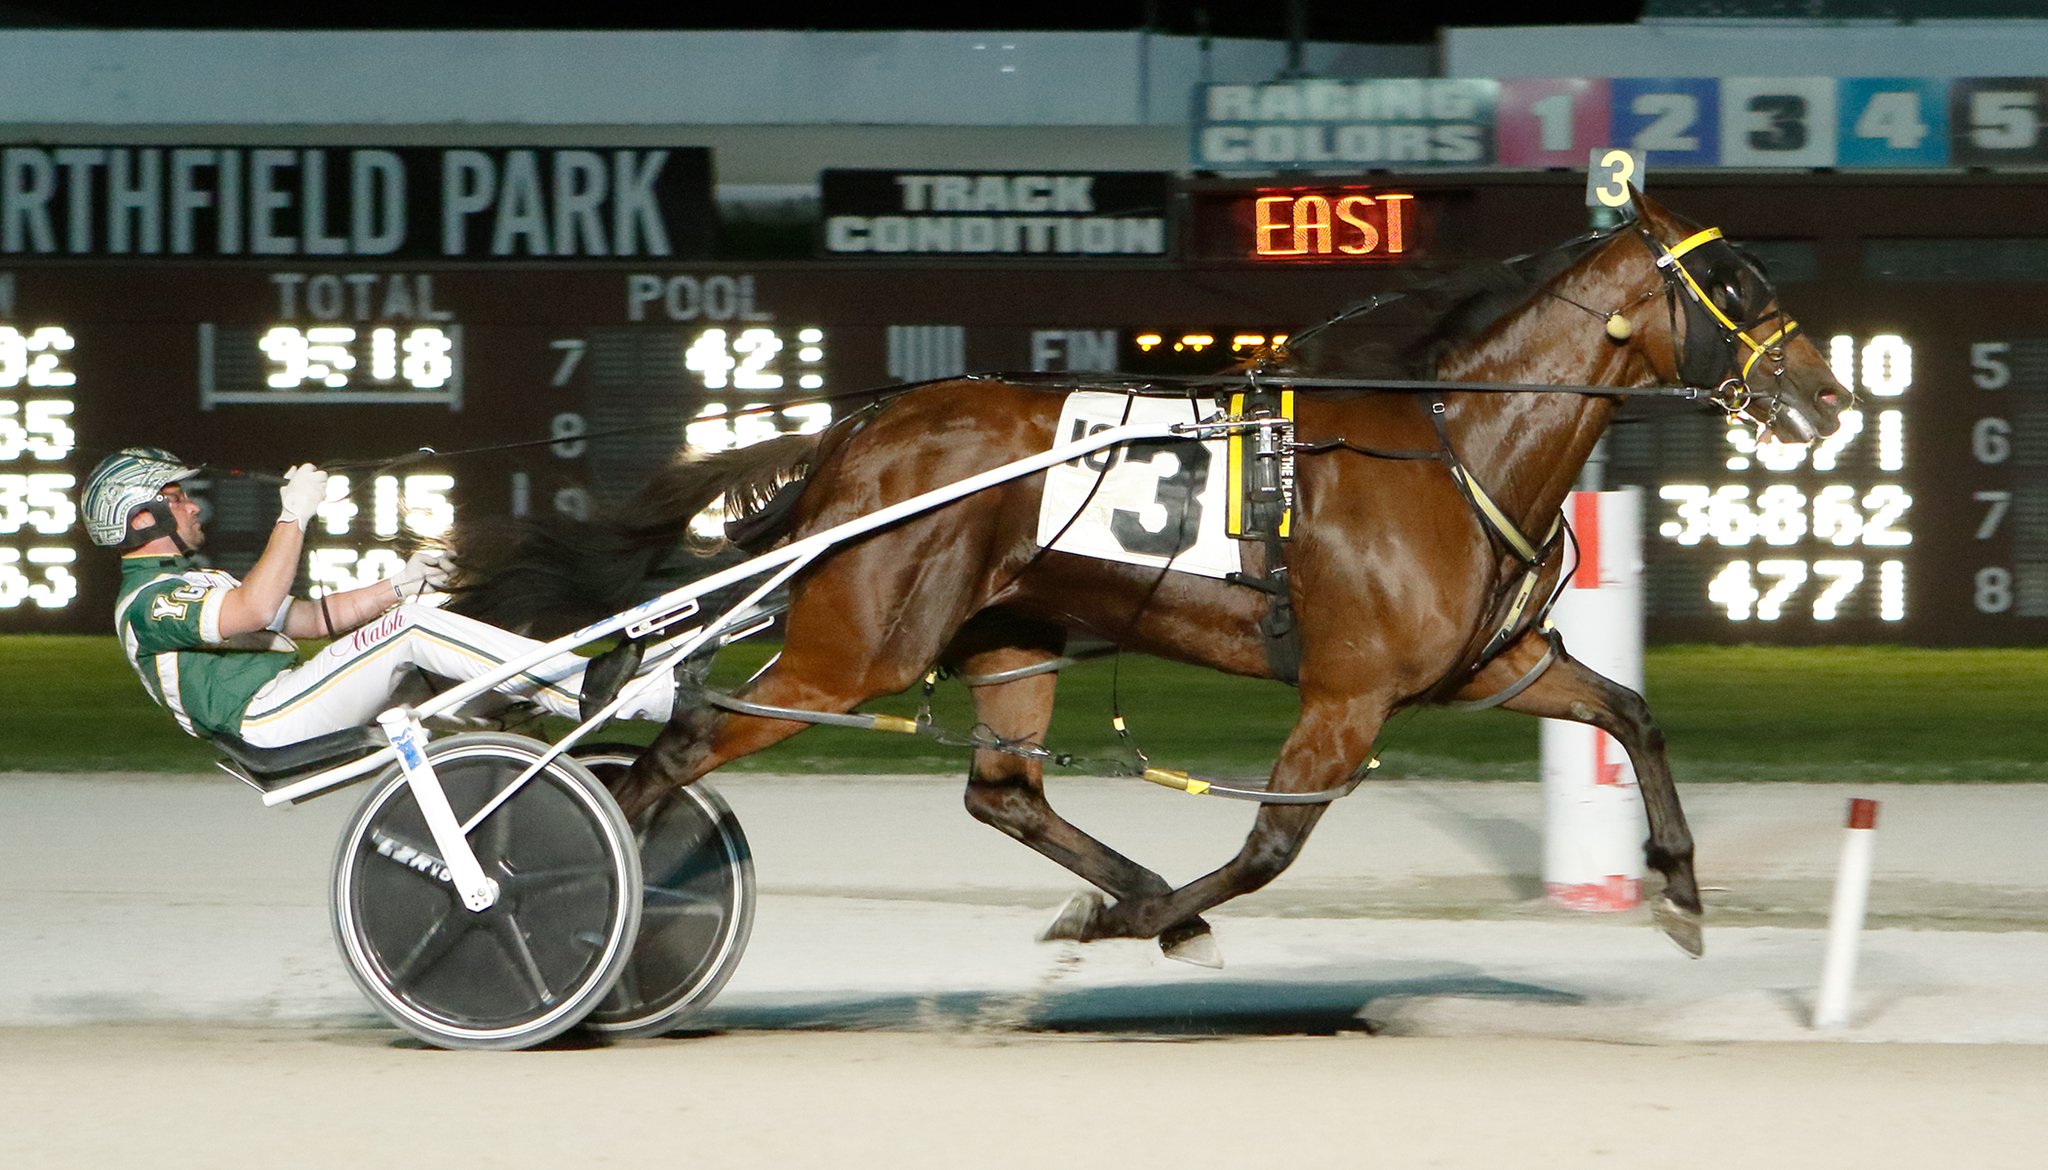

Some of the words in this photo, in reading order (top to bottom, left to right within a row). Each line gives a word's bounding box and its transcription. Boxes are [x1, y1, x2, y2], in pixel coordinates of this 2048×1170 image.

[1209, 85, 1479, 119] RACING
[1535, 96, 1575, 150] 1
[1631, 93, 1699, 151] 2
[1747, 94, 1808, 152] 3
[1857, 92, 1928, 149] 4
[1970, 92, 2041, 149] 5
[1203, 125, 1480, 162] COLORS
[2, 148, 405, 255] RTHFIELD
[442, 150, 671, 257] PARK
[896, 176, 1095, 212] TRACK
[1597, 150, 1635, 207] 3
[827, 216, 1165, 253] CONDITION
[1255, 194, 1414, 257] EAST
[271, 273, 454, 321] TOTAL
[627, 275, 776, 321] POOL
[551, 338, 586, 386] 7
[1971, 342, 2010, 390] 5
[552, 412, 586, 459] 8
[1972, 417, 2011, 464] 6
[1280, 456, 1294, 476] THE
[1110, 437, 1212, 558] 3
[1659, 484, 1913, 546] 36862
[1973, 490, 2011, 540] 7
[1708, 559, 1905, 621] 4771
[1974, 566, 2012, 613] 8
[330, 607, 406, 657] Walsh
